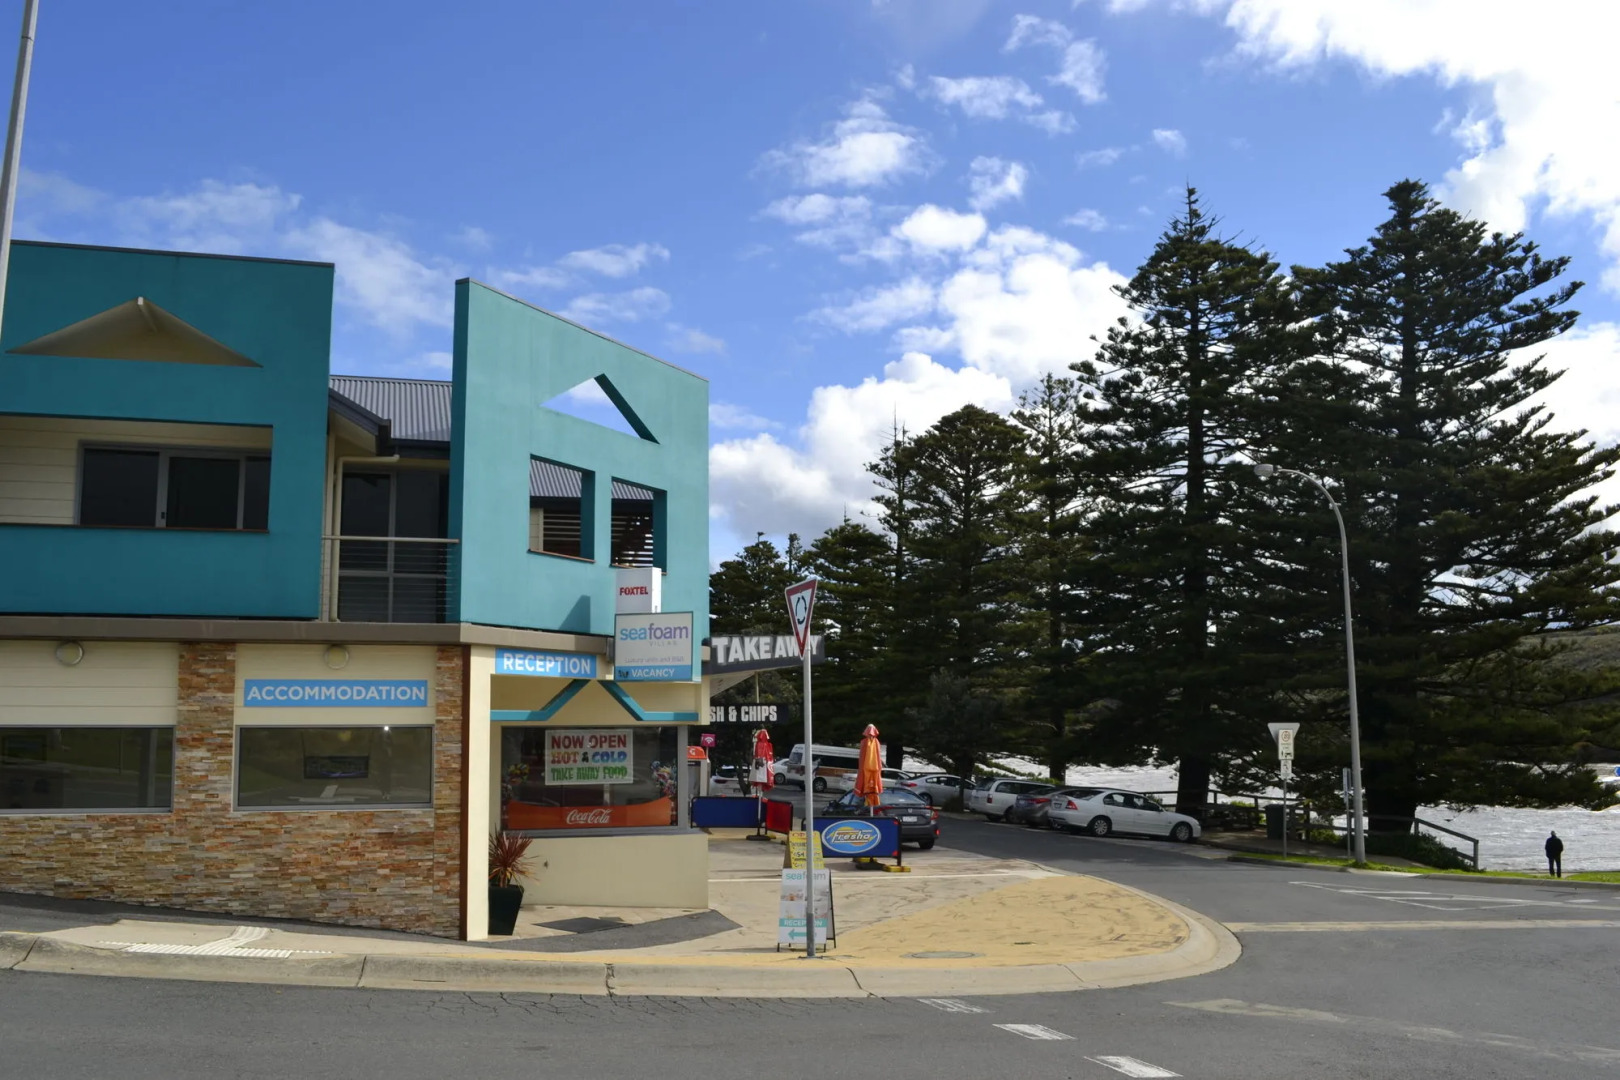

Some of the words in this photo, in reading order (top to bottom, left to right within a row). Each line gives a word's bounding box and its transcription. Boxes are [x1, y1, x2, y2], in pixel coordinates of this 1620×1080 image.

[619, 586, 649, 596] FOXTEL
[620, 622, 689, 641] seafoam
[711, 636, 772, 665] TAKE
[774, 635, 823, 658] AWY
[502, 653, 591, 675] RECEPTION
[631, 668, 675, 678] VACANCY
[247, 685, 425, 701] ACCOMMODATION
[728, 705, 738, 722] &
[741, 705, 778, 722] CHIPS
[551, 735, 585, 749] NOW
[588, 734, 627, 749] OPEN
[550, 751, 579, 764] HOT
[581, 751, 589, 763] &
[591, 750, 628, 764] COLD
[550, 766, 574, 781] TAKE
[576, 766, 600, 780] AWAY
[603, 765, 628, 779] FOOD
[785, 870, 826, 880] seafam
